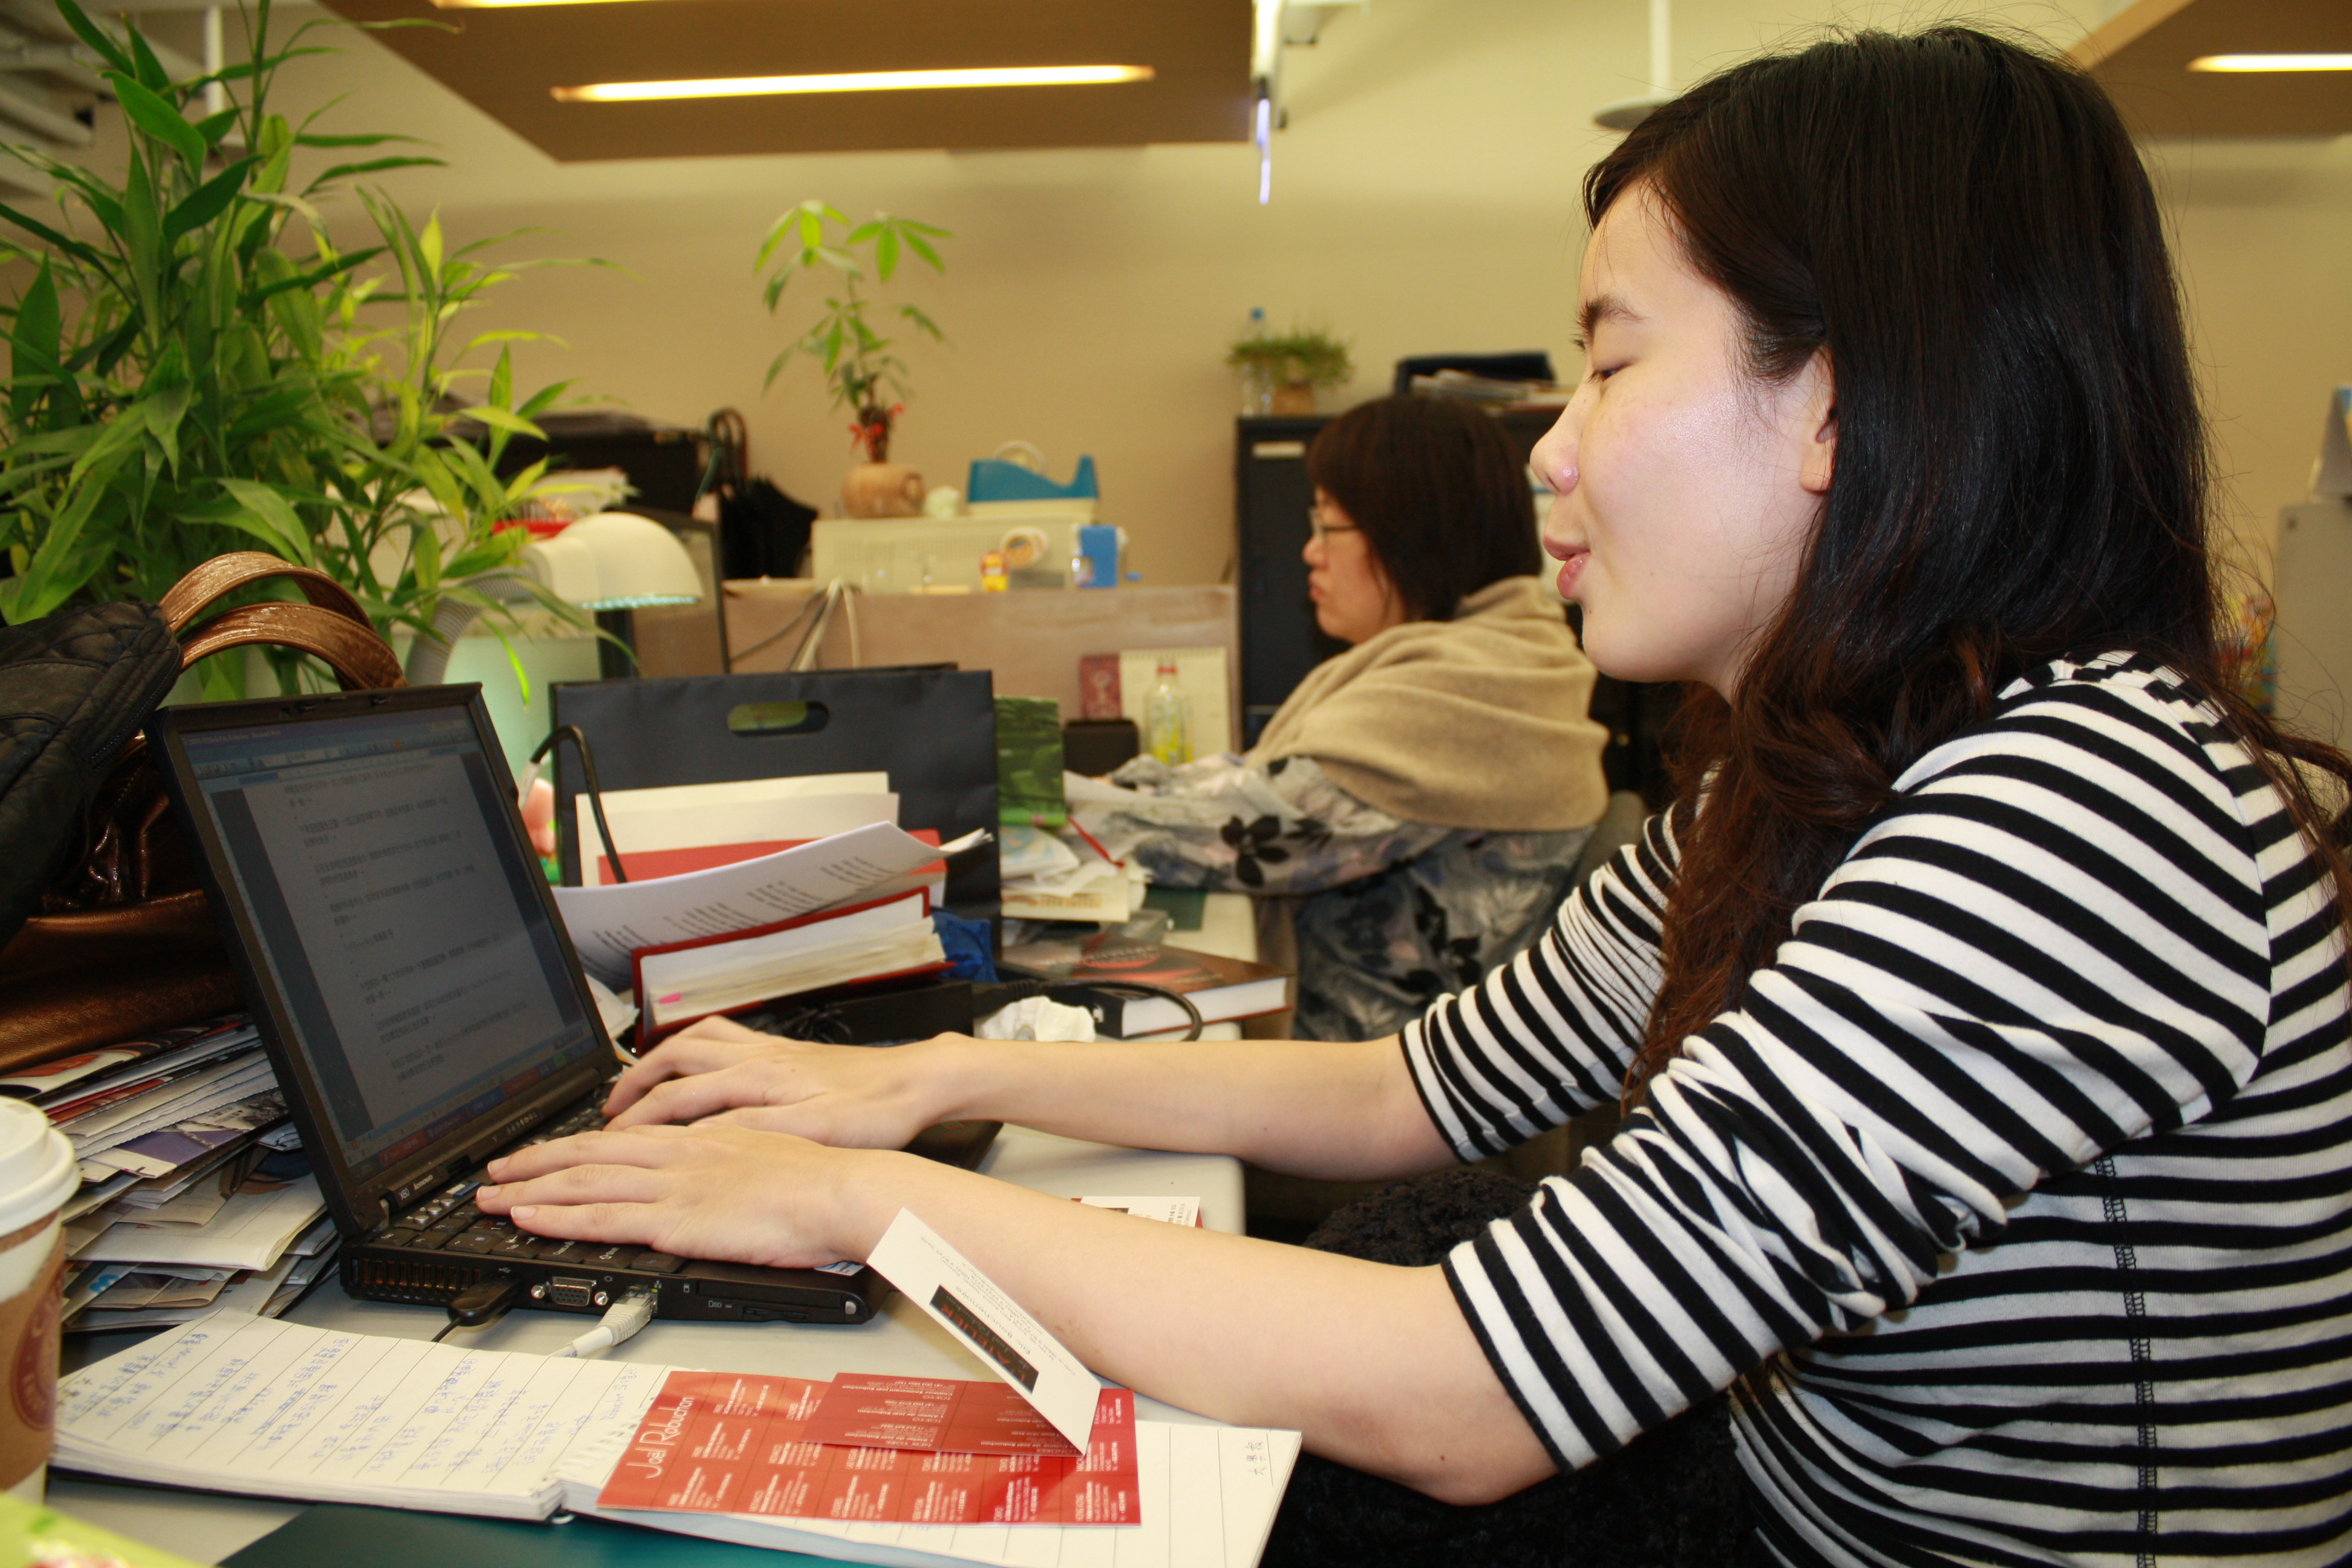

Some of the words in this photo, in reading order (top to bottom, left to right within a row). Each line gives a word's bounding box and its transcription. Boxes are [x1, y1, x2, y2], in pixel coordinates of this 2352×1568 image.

[399, 1187, 410, 1201] X60
[413, 1174, 434, 1191] lenovo
[953, 1285, 1013, 1339] Bouchenoire
[937, 1302, 1027, 1383] L'ATELIER
[639, 1396, 696, 1445] Robuchon
[627, 1446, 669, 1478] Joël
